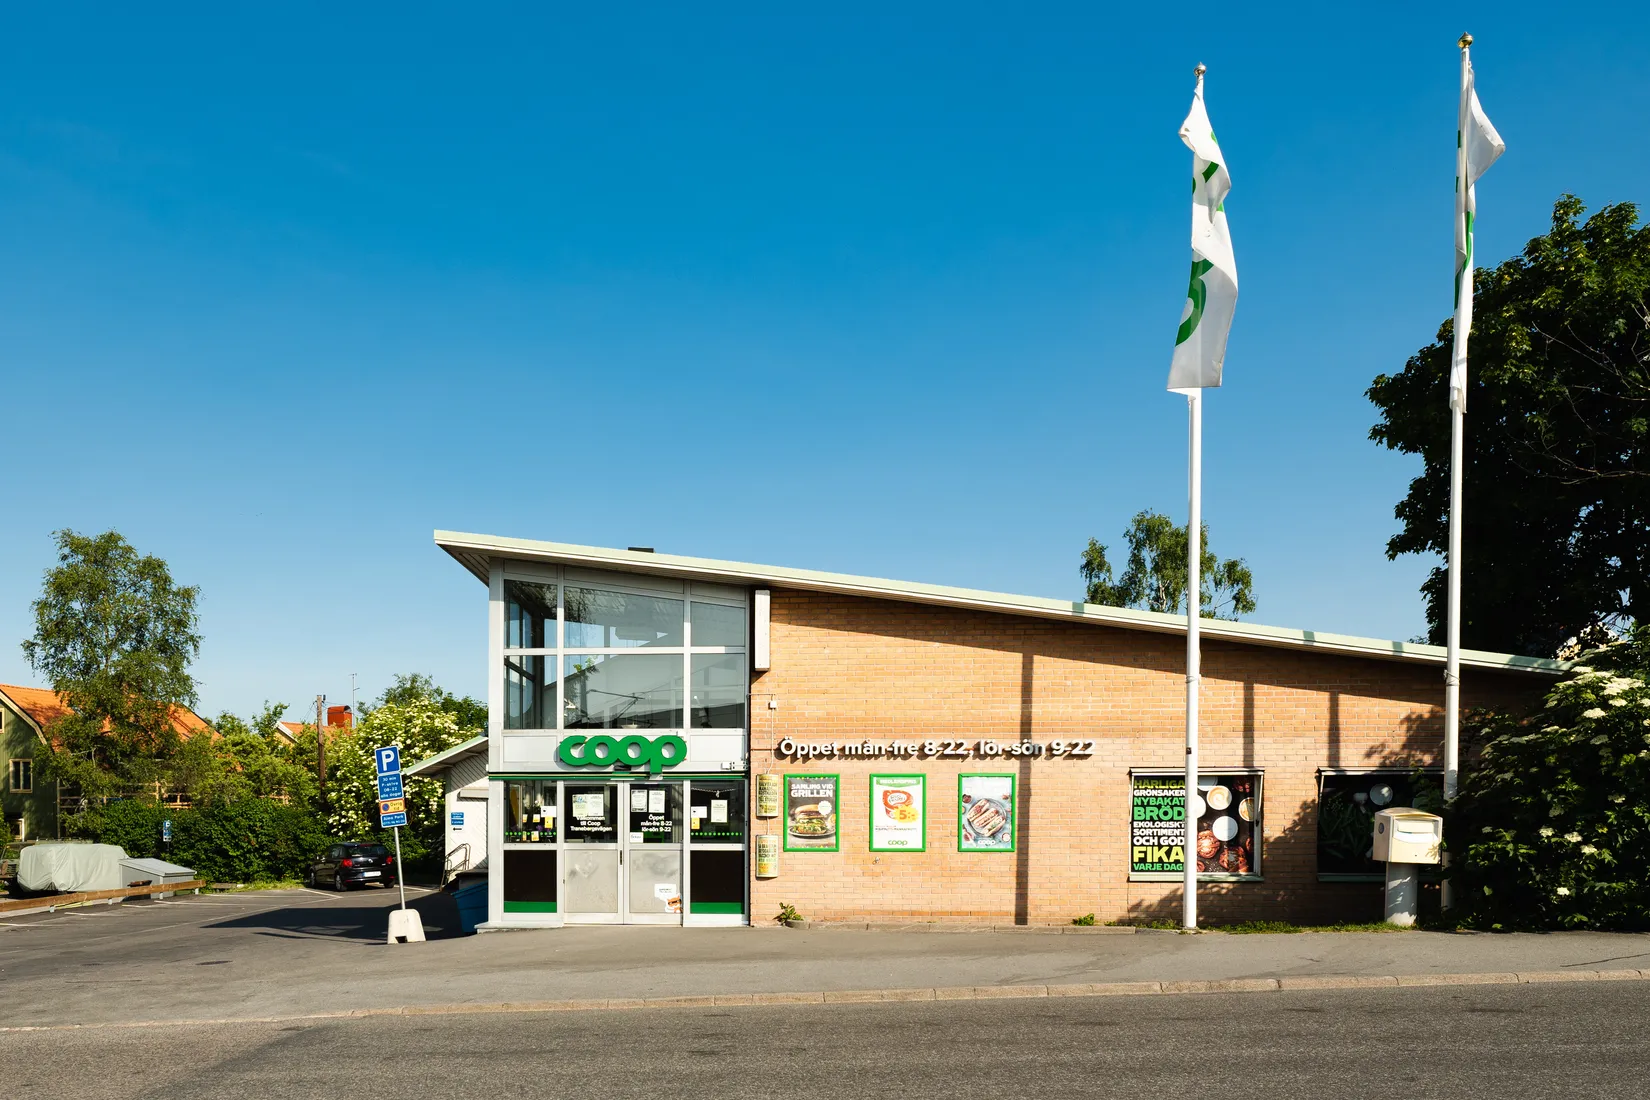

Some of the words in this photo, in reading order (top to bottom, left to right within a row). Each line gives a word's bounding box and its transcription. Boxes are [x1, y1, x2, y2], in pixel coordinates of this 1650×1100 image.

[780, 736, 838, 758] Öppet
[845, 738, 918, 755] mån-fre
[924, 740, 974, 757] 8-22,
[980, 739, 1045, 755] lör-sön
[1051, 739, 1096, 755] 9-22
[381, 750, 395, 771] P
[560, 735, 687, 774] coop
[1134, 779, 1186, 788] HÄRLIGA
[791, 790, 832, 798] GRILLEN
[1134, 788, 1186, 796] GRÖNSAKER
[1134, 797, 1186, 806] NYBAKAT
[1134, 805, 1186, 820] BRÖD
[1133, 836, 1158, 846] OCH
[1160, 836, 1185, 846] GOD
[1133, 846, 1185, 862] FIKA
